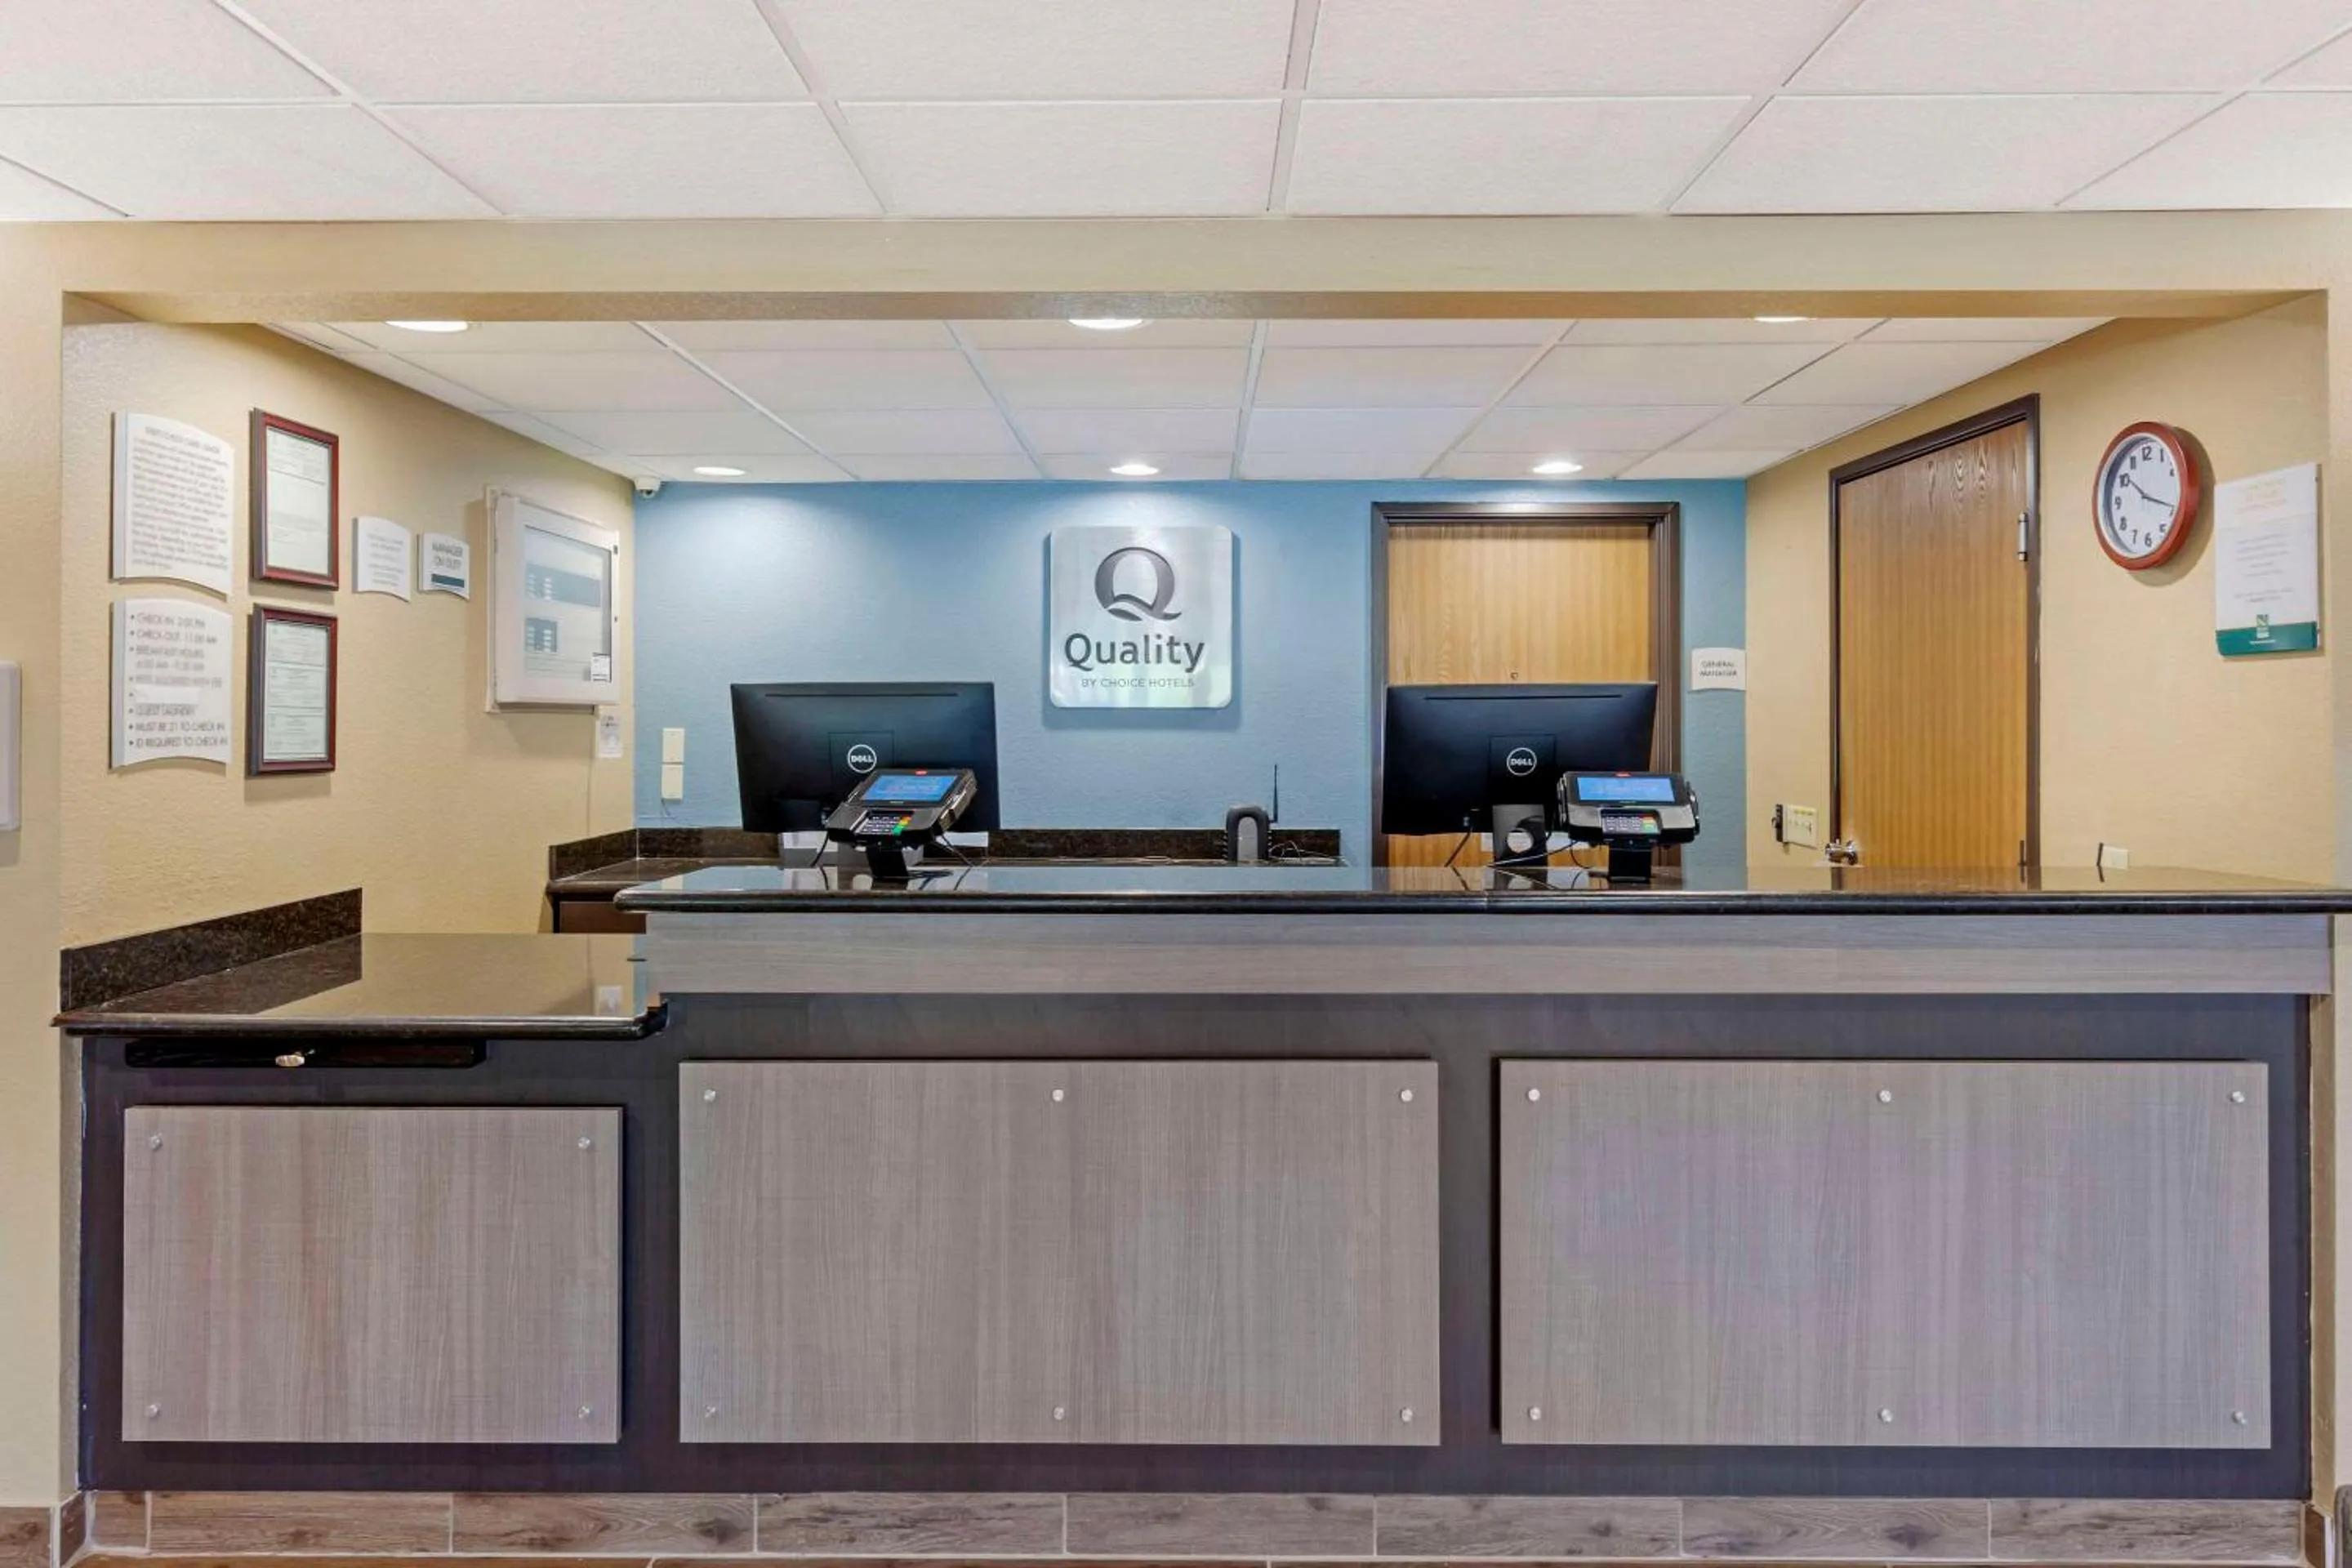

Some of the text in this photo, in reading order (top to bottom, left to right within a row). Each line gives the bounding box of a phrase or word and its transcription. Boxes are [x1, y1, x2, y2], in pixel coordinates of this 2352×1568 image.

[2141, 446, 2152, 461] 12
[2159, 448, 2164, 463] 1
[2130, 457, 2136, 470] 11
[2119, 473, 2131, 488] 10
[2114, 496, 2122, 510] 9
[2119, 516, 2127, 532] 8
[2132, 529, 2138, 544] 7
[2145, 532, 2152, 547] 6
[1094, 546, 1182, 621] Q
[137, 612, 162, 625] CHECK
[136, 628, 162, 640] CHECK
[1064, 633, 1205, 673] Quality
[1082, 678, 1195, 688] BY CHOICE HOTELS
[850, 755, 873, 763] DELL
[1511, 758, 1533, 766] DELL
